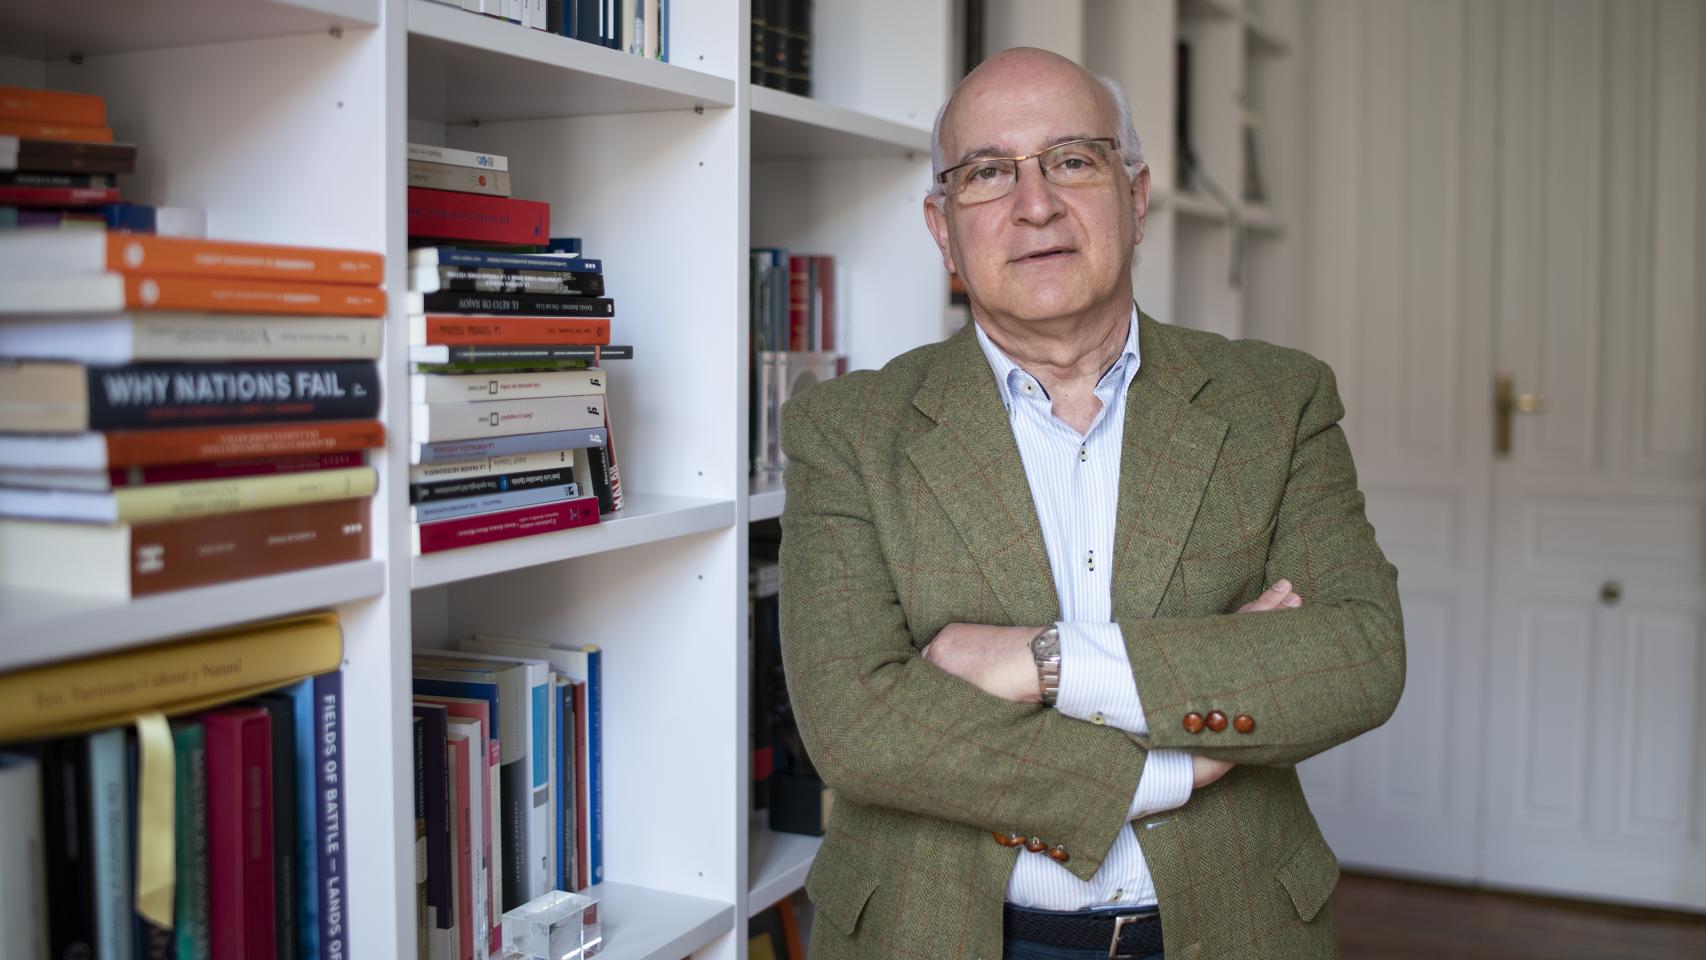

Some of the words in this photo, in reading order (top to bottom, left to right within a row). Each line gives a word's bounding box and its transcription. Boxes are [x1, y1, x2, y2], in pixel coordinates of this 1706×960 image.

[481, 300, 492, 310] DE
[103, 372, 170, 406] WHY
[172, 371, 292, 404] NATIONS
[295, 370, 346, 400] FAIL
[322, 694, 338, 756] FIELDS
[325, 760, 338, 783] OF
[326, 788, 340, 854] BATTLE
[328, 876, 342, 936] LANDS
